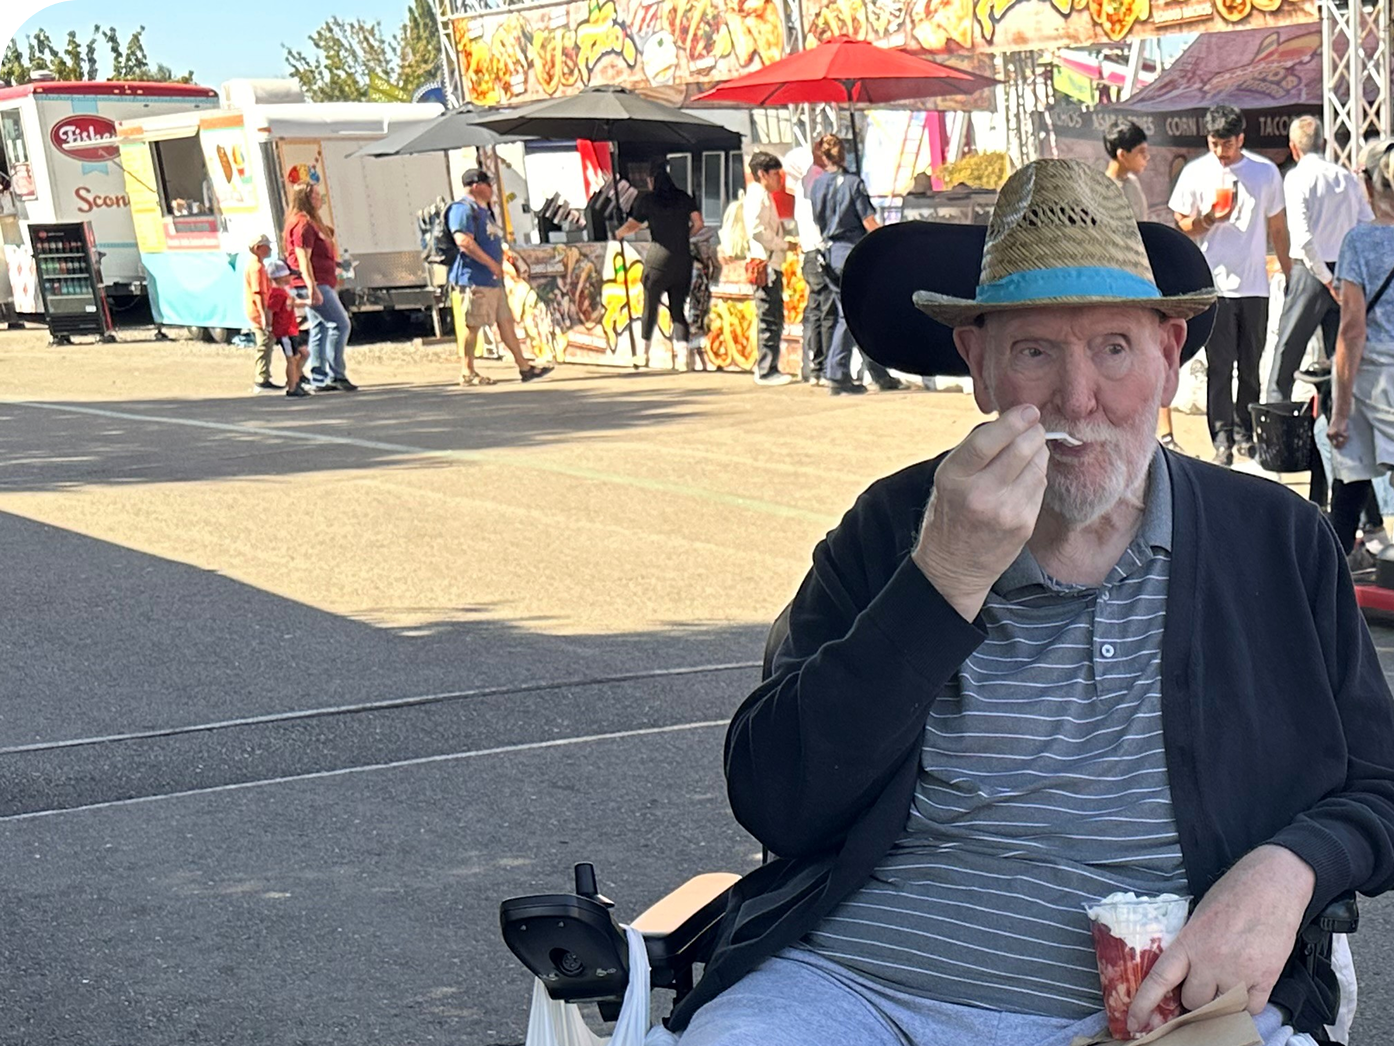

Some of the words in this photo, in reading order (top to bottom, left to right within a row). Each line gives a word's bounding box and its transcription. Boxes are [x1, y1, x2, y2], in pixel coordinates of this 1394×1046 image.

[58, 125, 118, 145] Fishe
[1165, 116, 1197, 136] CORN
[1258, 114, 1294, 136] TACO
[74, 186, 131, 213] Scon
